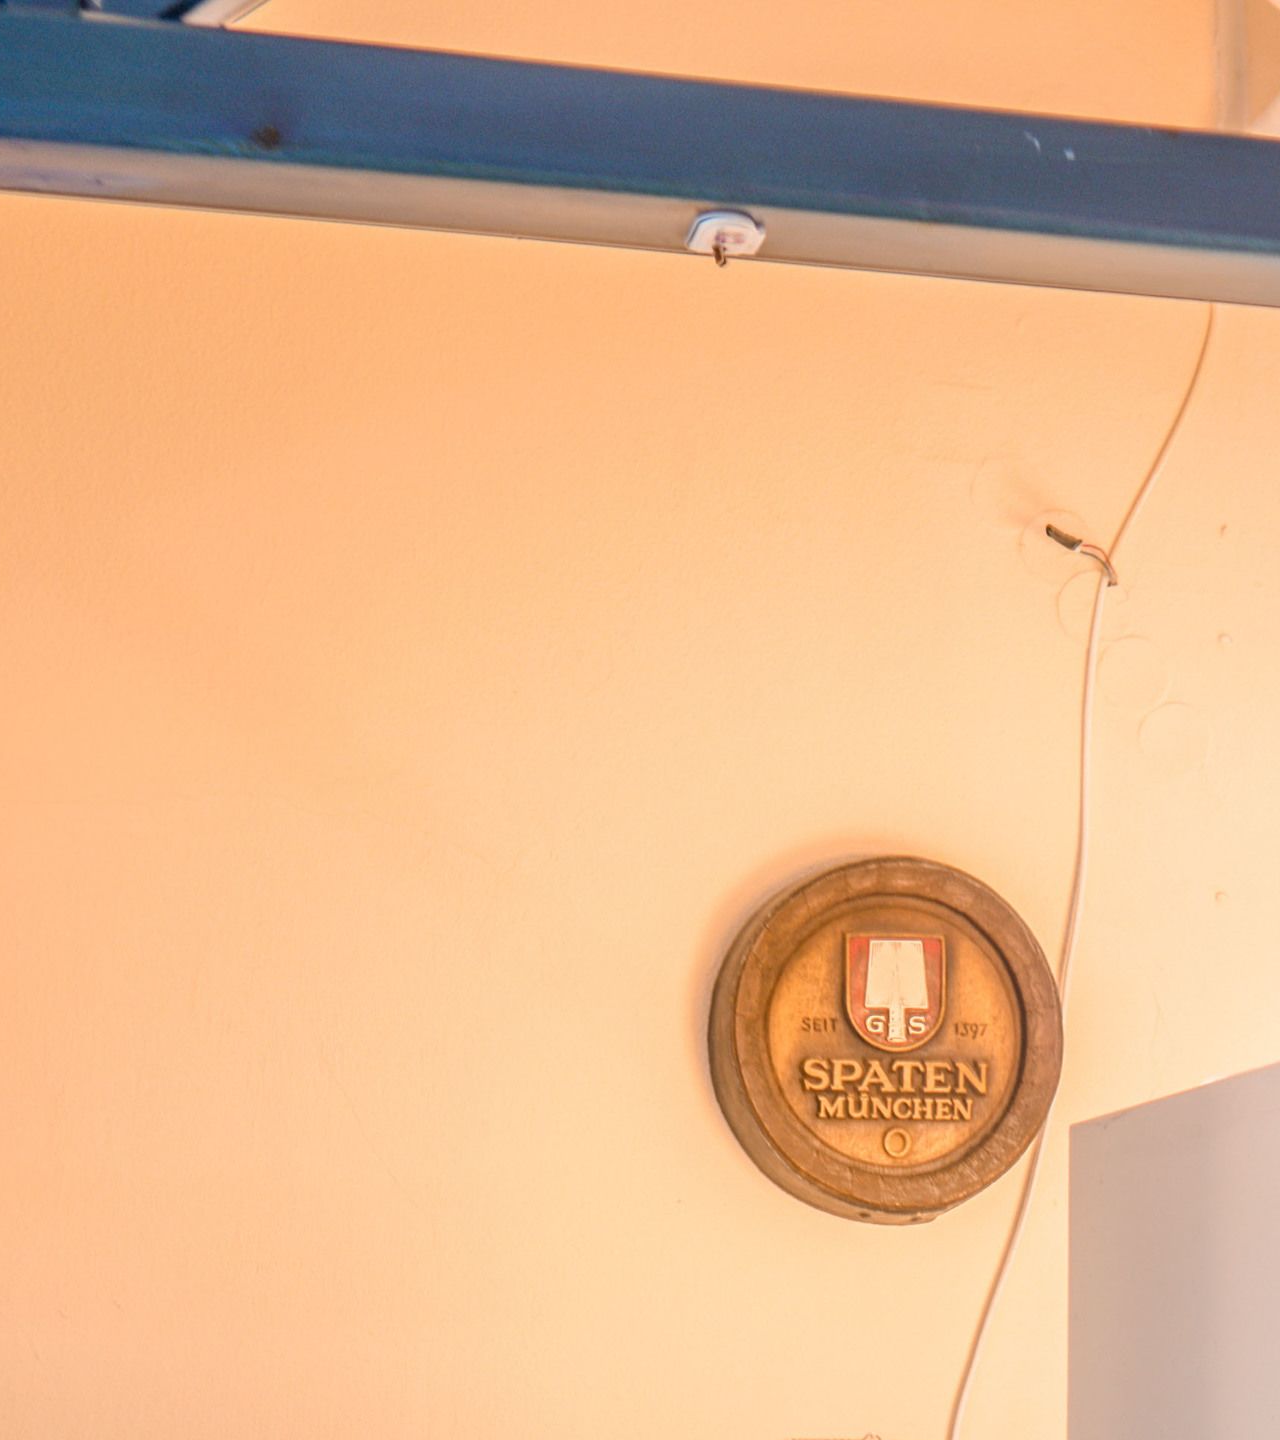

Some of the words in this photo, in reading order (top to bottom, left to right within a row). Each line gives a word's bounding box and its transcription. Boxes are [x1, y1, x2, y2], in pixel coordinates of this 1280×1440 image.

[800, 1015, 839, 1033] SEIT
[801, 1058, 989, 1096] SPATEN
[816, 1093, 974, 1122] MÜNCHEN
